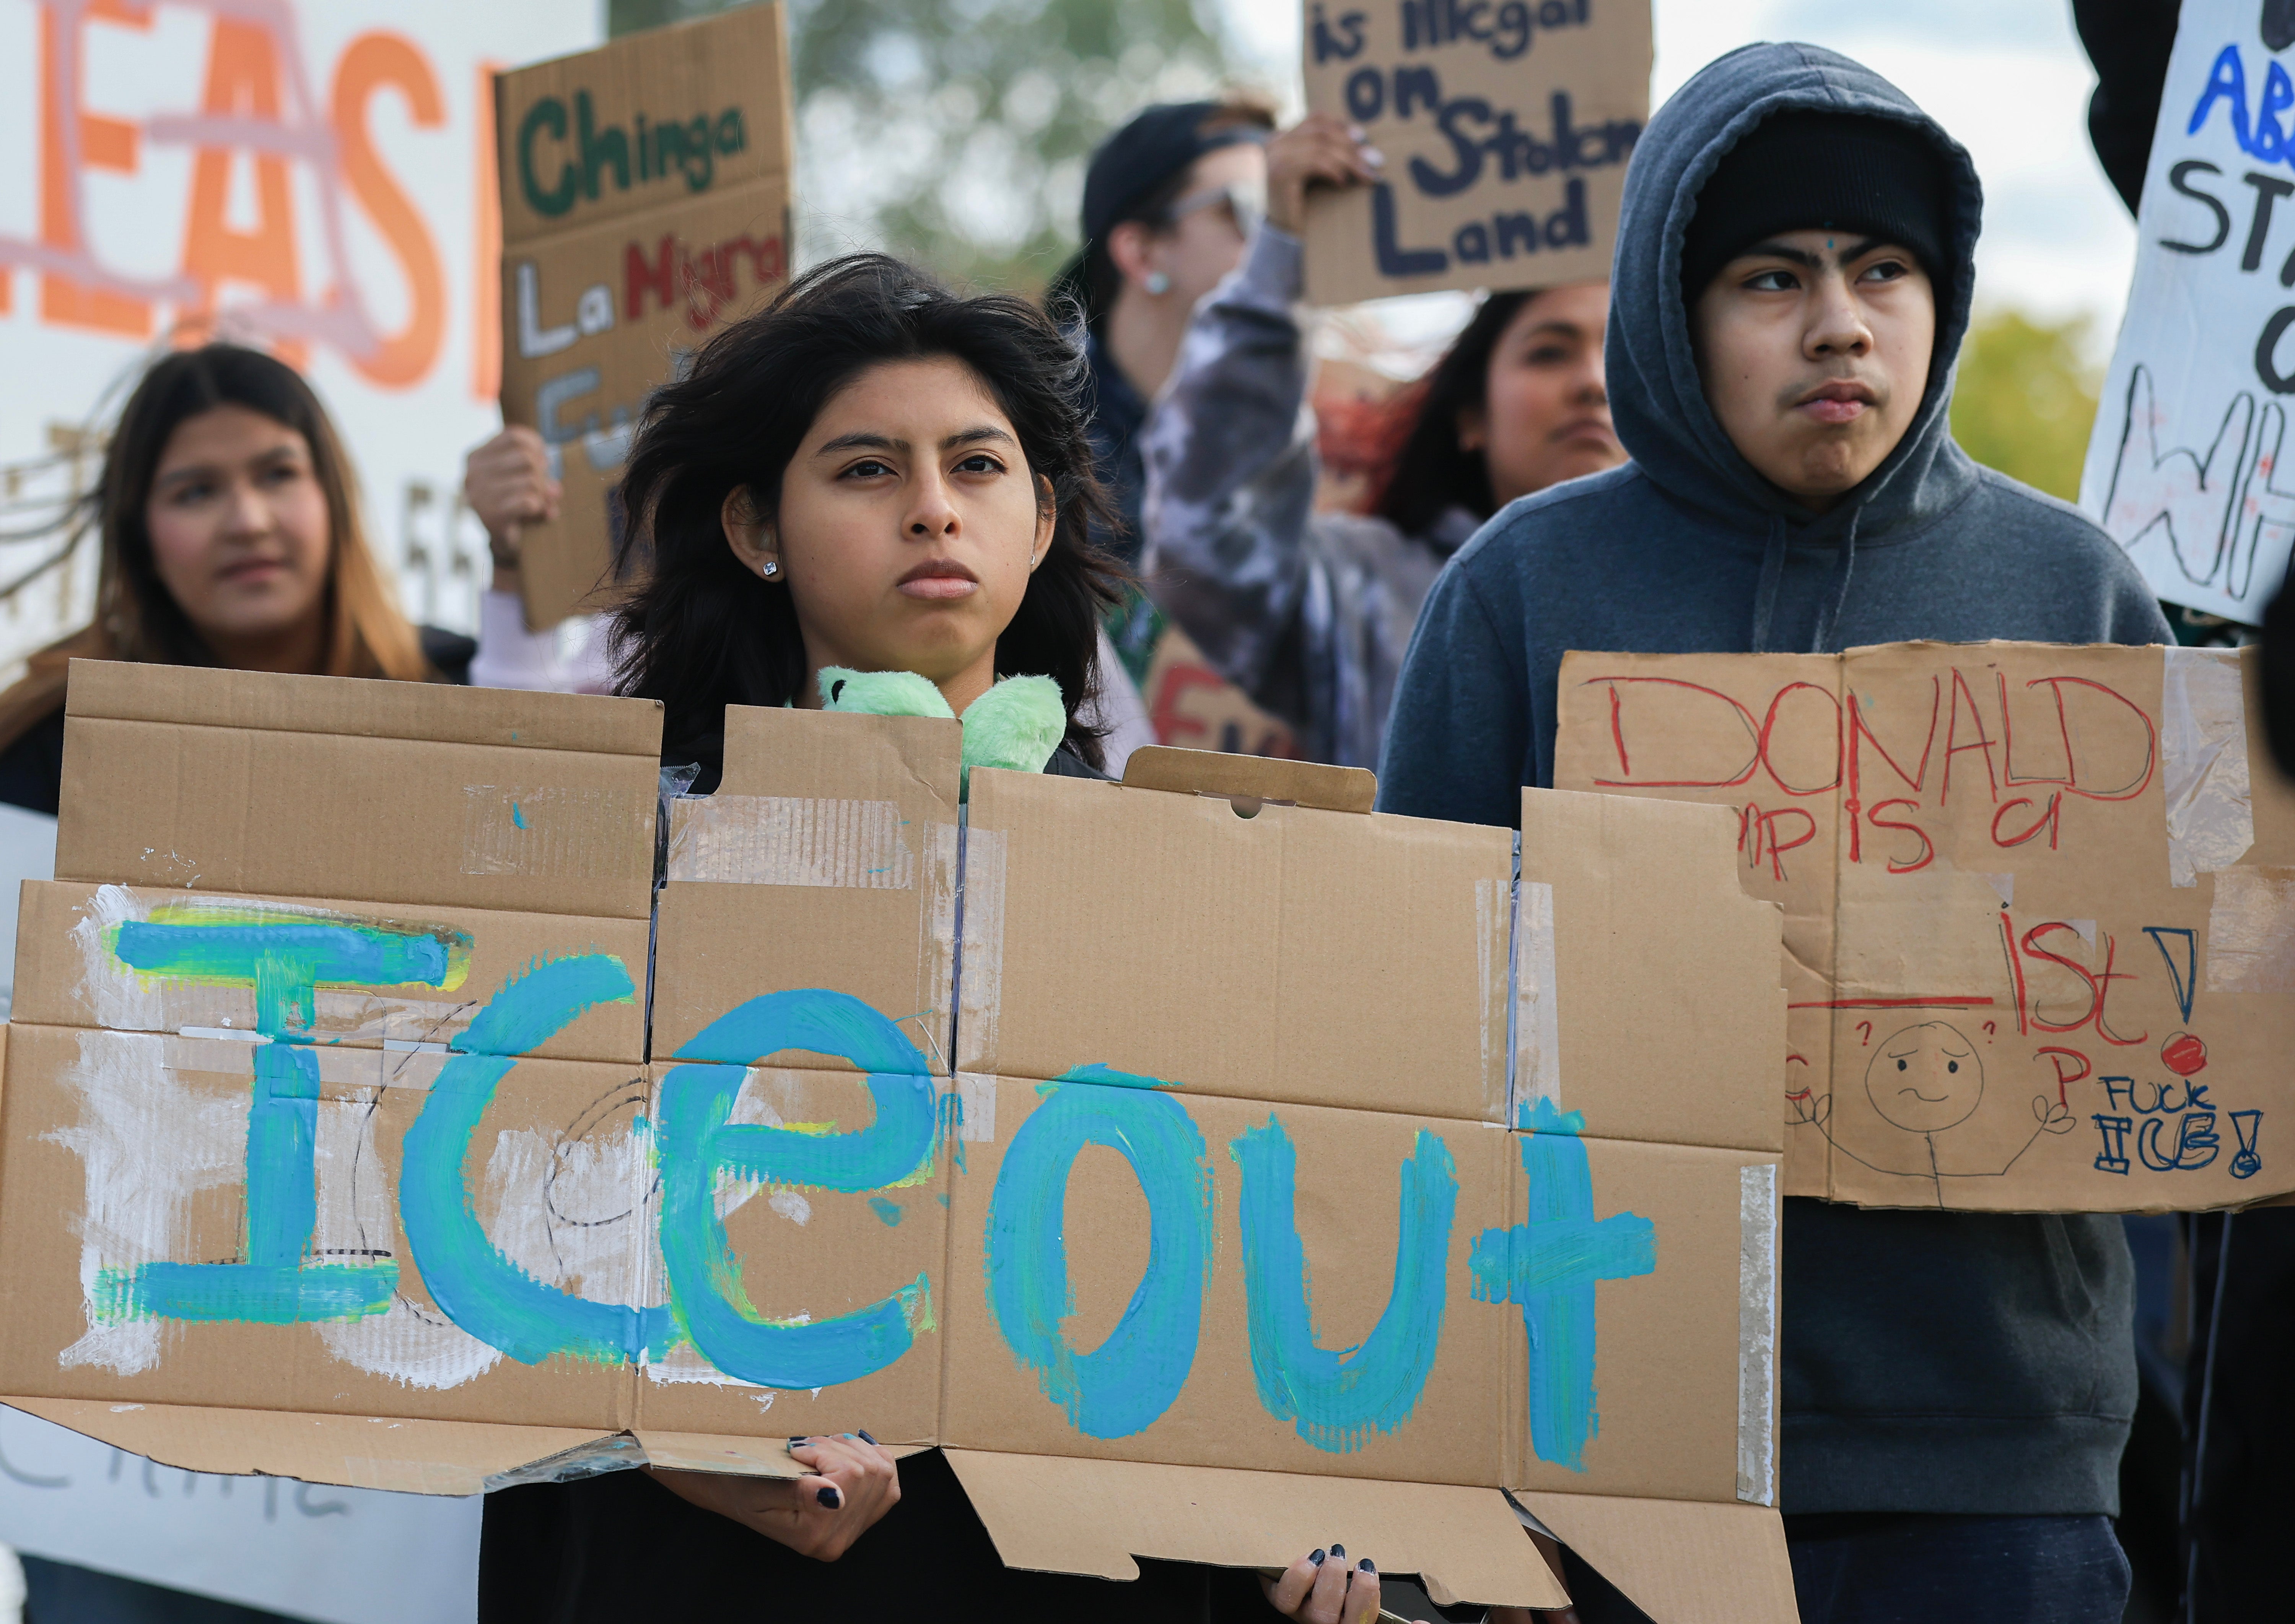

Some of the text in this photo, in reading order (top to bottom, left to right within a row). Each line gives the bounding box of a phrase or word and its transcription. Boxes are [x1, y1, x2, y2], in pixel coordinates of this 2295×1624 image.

[1346, 63, 1441, 122] on
[519, 89, 748, 218] Chinga
[1370, 176, 1592, 278] Land
[516, 262, 614, 359] La
[1578, 665, 2156, 806] DONALD
